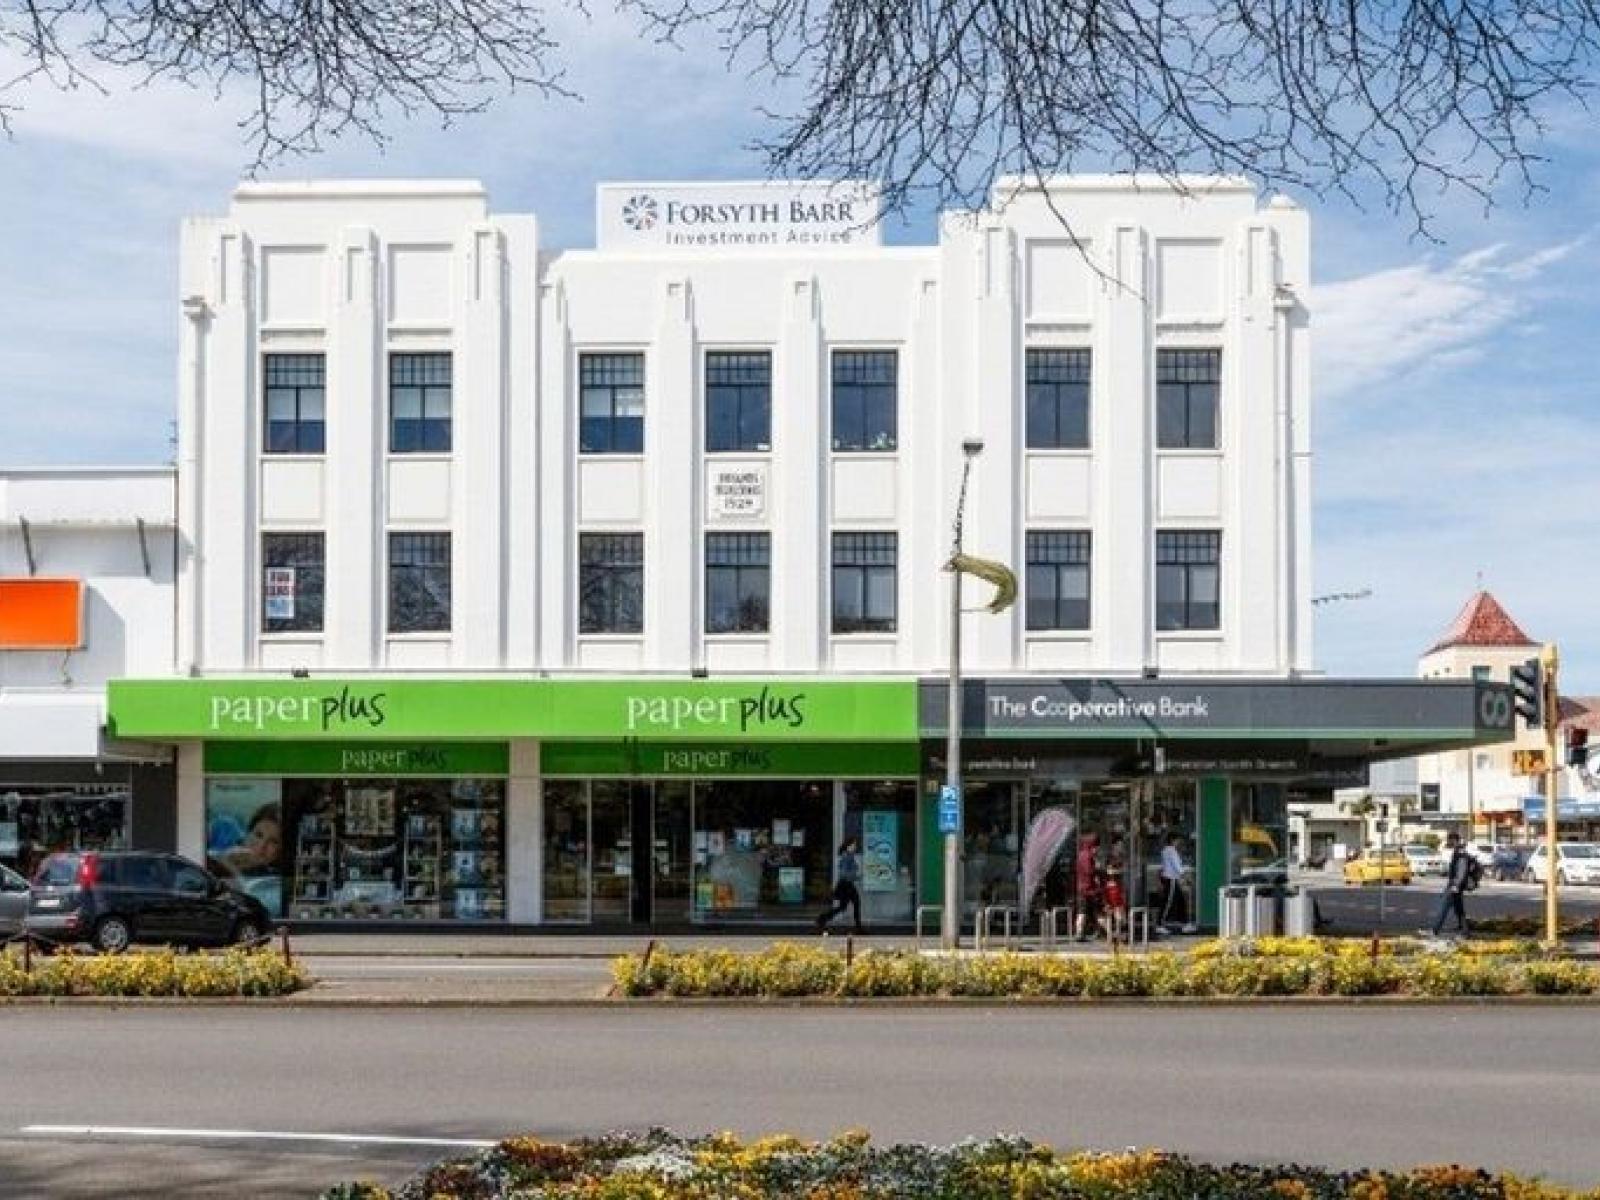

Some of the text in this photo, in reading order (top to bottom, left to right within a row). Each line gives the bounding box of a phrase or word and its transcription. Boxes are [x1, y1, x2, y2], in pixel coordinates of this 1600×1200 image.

[666, 200, 854, 224] FORSYTH BARR
[665, 230, 779, 245] Investment
[989, 695, 1209, 722] The Cooperative Bank
